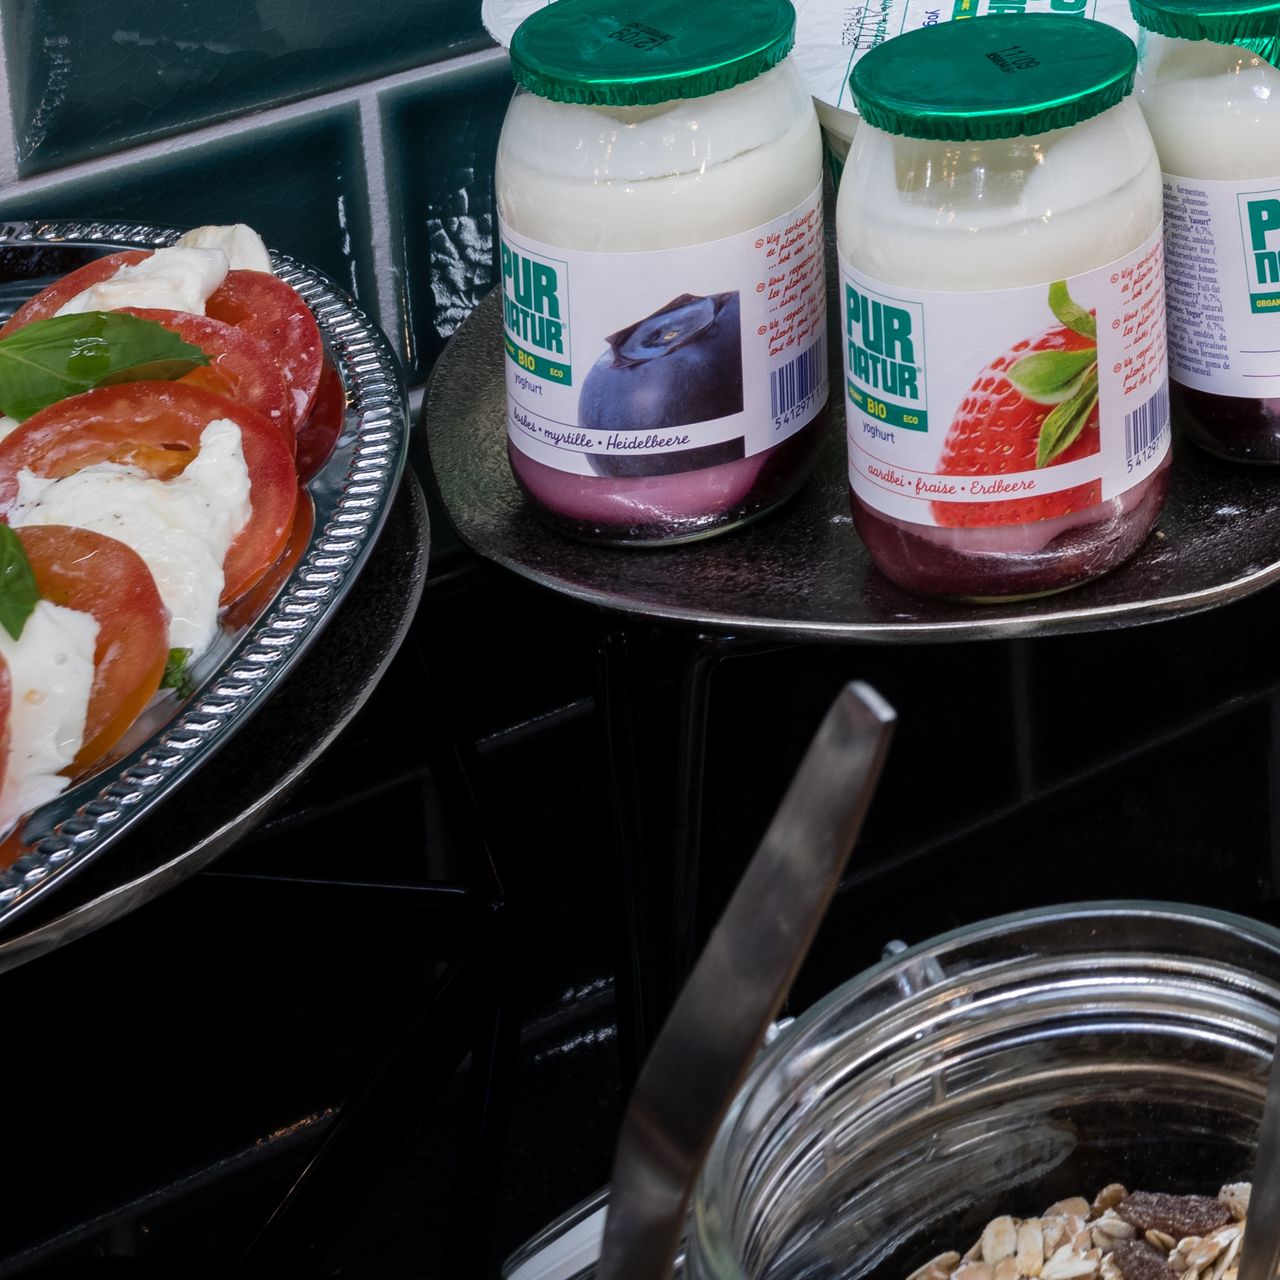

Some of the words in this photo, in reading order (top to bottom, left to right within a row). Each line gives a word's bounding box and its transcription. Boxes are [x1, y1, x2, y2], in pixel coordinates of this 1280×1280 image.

[607, 26, 664, 52] 12/09
[1000, 45, 1041, 70] 11/09
[501, 238, 561, 320] PUR
[1197, 282, 1221, 294] Full-fat
[1201, 301, 1223, 313] natural
[504, 290, 564, 355] NATUR
[845, 281, 915, 364] PUR
[1219, 333, 1227, 342] de
[517, 349, 536, 371] BIO
[549, 367, 564, 379] ECO
[848, 337, 919, 400] NATUR
[514, 371, 543, 396] yoghurt
[867, 397, 887, 419] BIO
[903, 414, 918, 425] ECO
[513, 405, 536, 433] bosbes
[544, 426, 594, 450] myrtille
[606, 431, 692, 450] Heidelbeere
[862, 420, 895, 444] yoghurt
[867, 463, 904, 487] aardbei
[914, 479, 957, 495] fraise
[969, 478, 1037, 495] Erdbeere
[1126, 460, 1133, 473] 5
